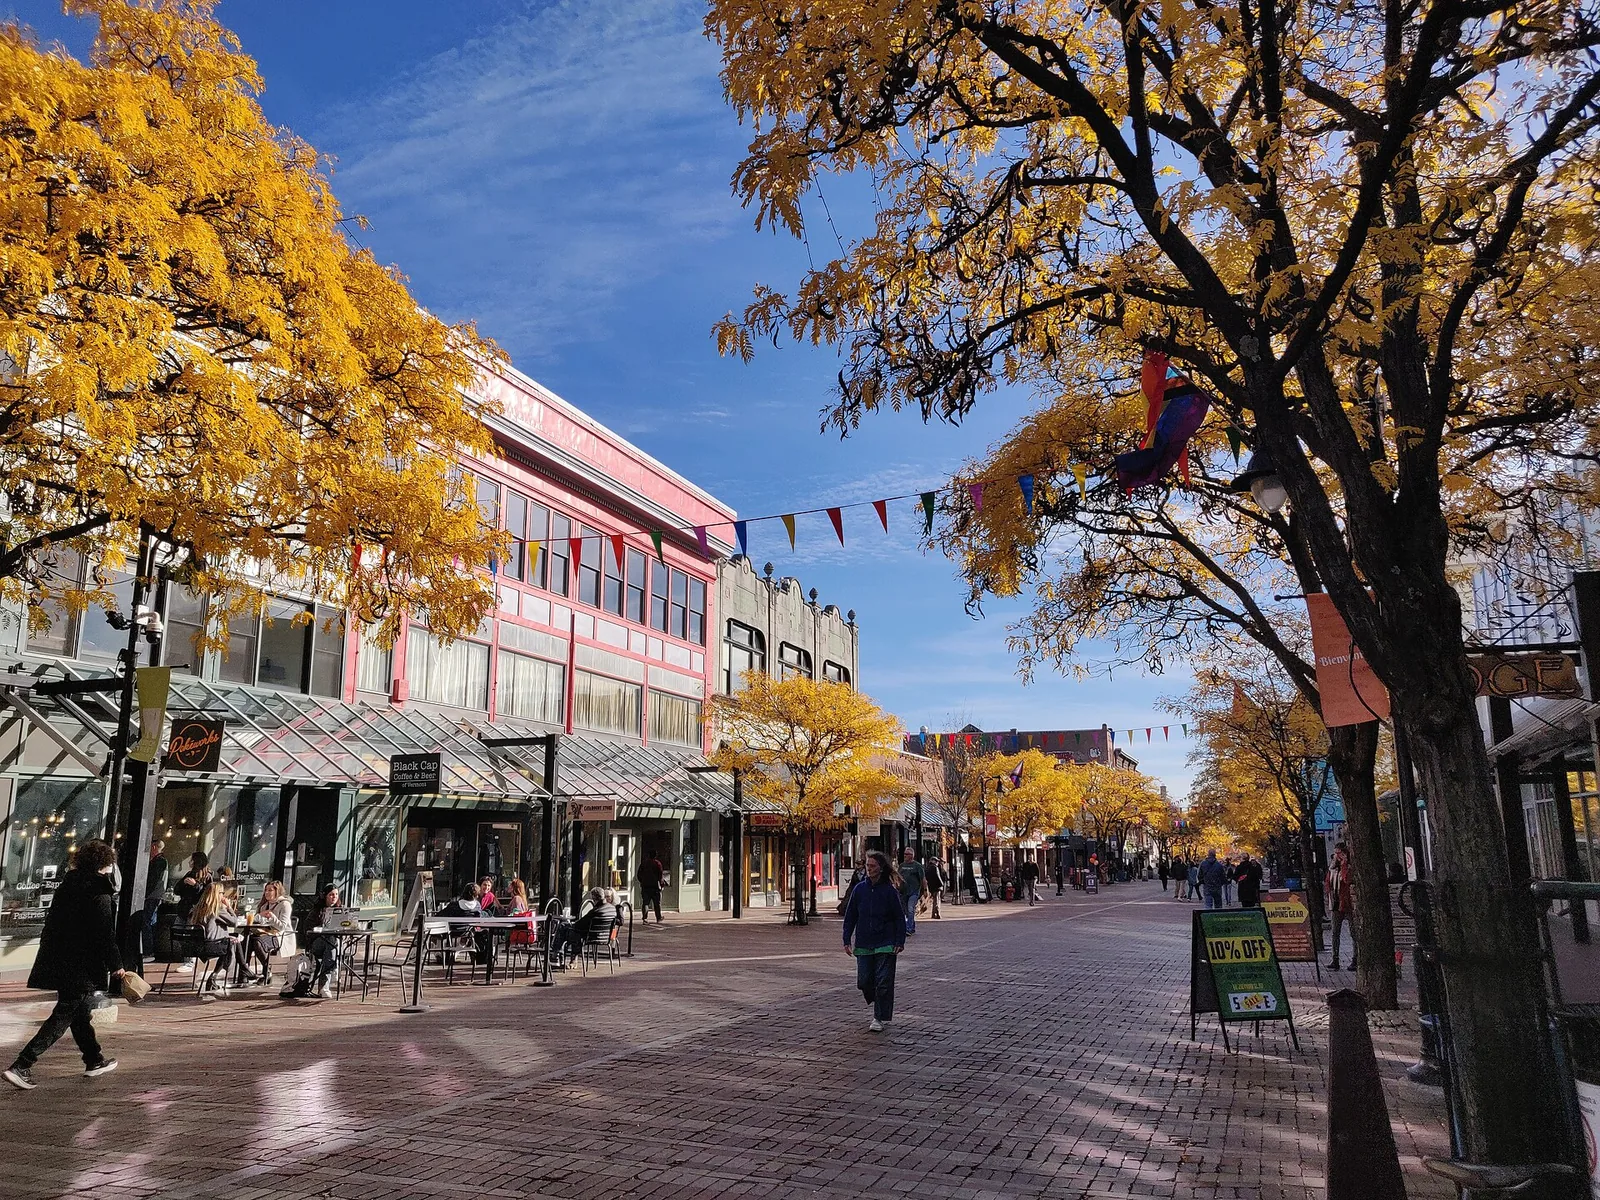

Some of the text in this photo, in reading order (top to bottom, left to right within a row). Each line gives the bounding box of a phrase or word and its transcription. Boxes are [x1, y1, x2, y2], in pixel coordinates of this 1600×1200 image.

[1320, 652, 1364, 668] Bienvn
[393, 760, 438, 771] Black Cap
[414, 772, 420, 780] &
[45, 881, 63, 890] Esp
[13, 911, 46, 920] Pastries
[1267, 910, 1304, 918] AMPING GEAR
[1209, 940, 1241, 960] 10%
[1242, 939, 1267, 959] OFF
